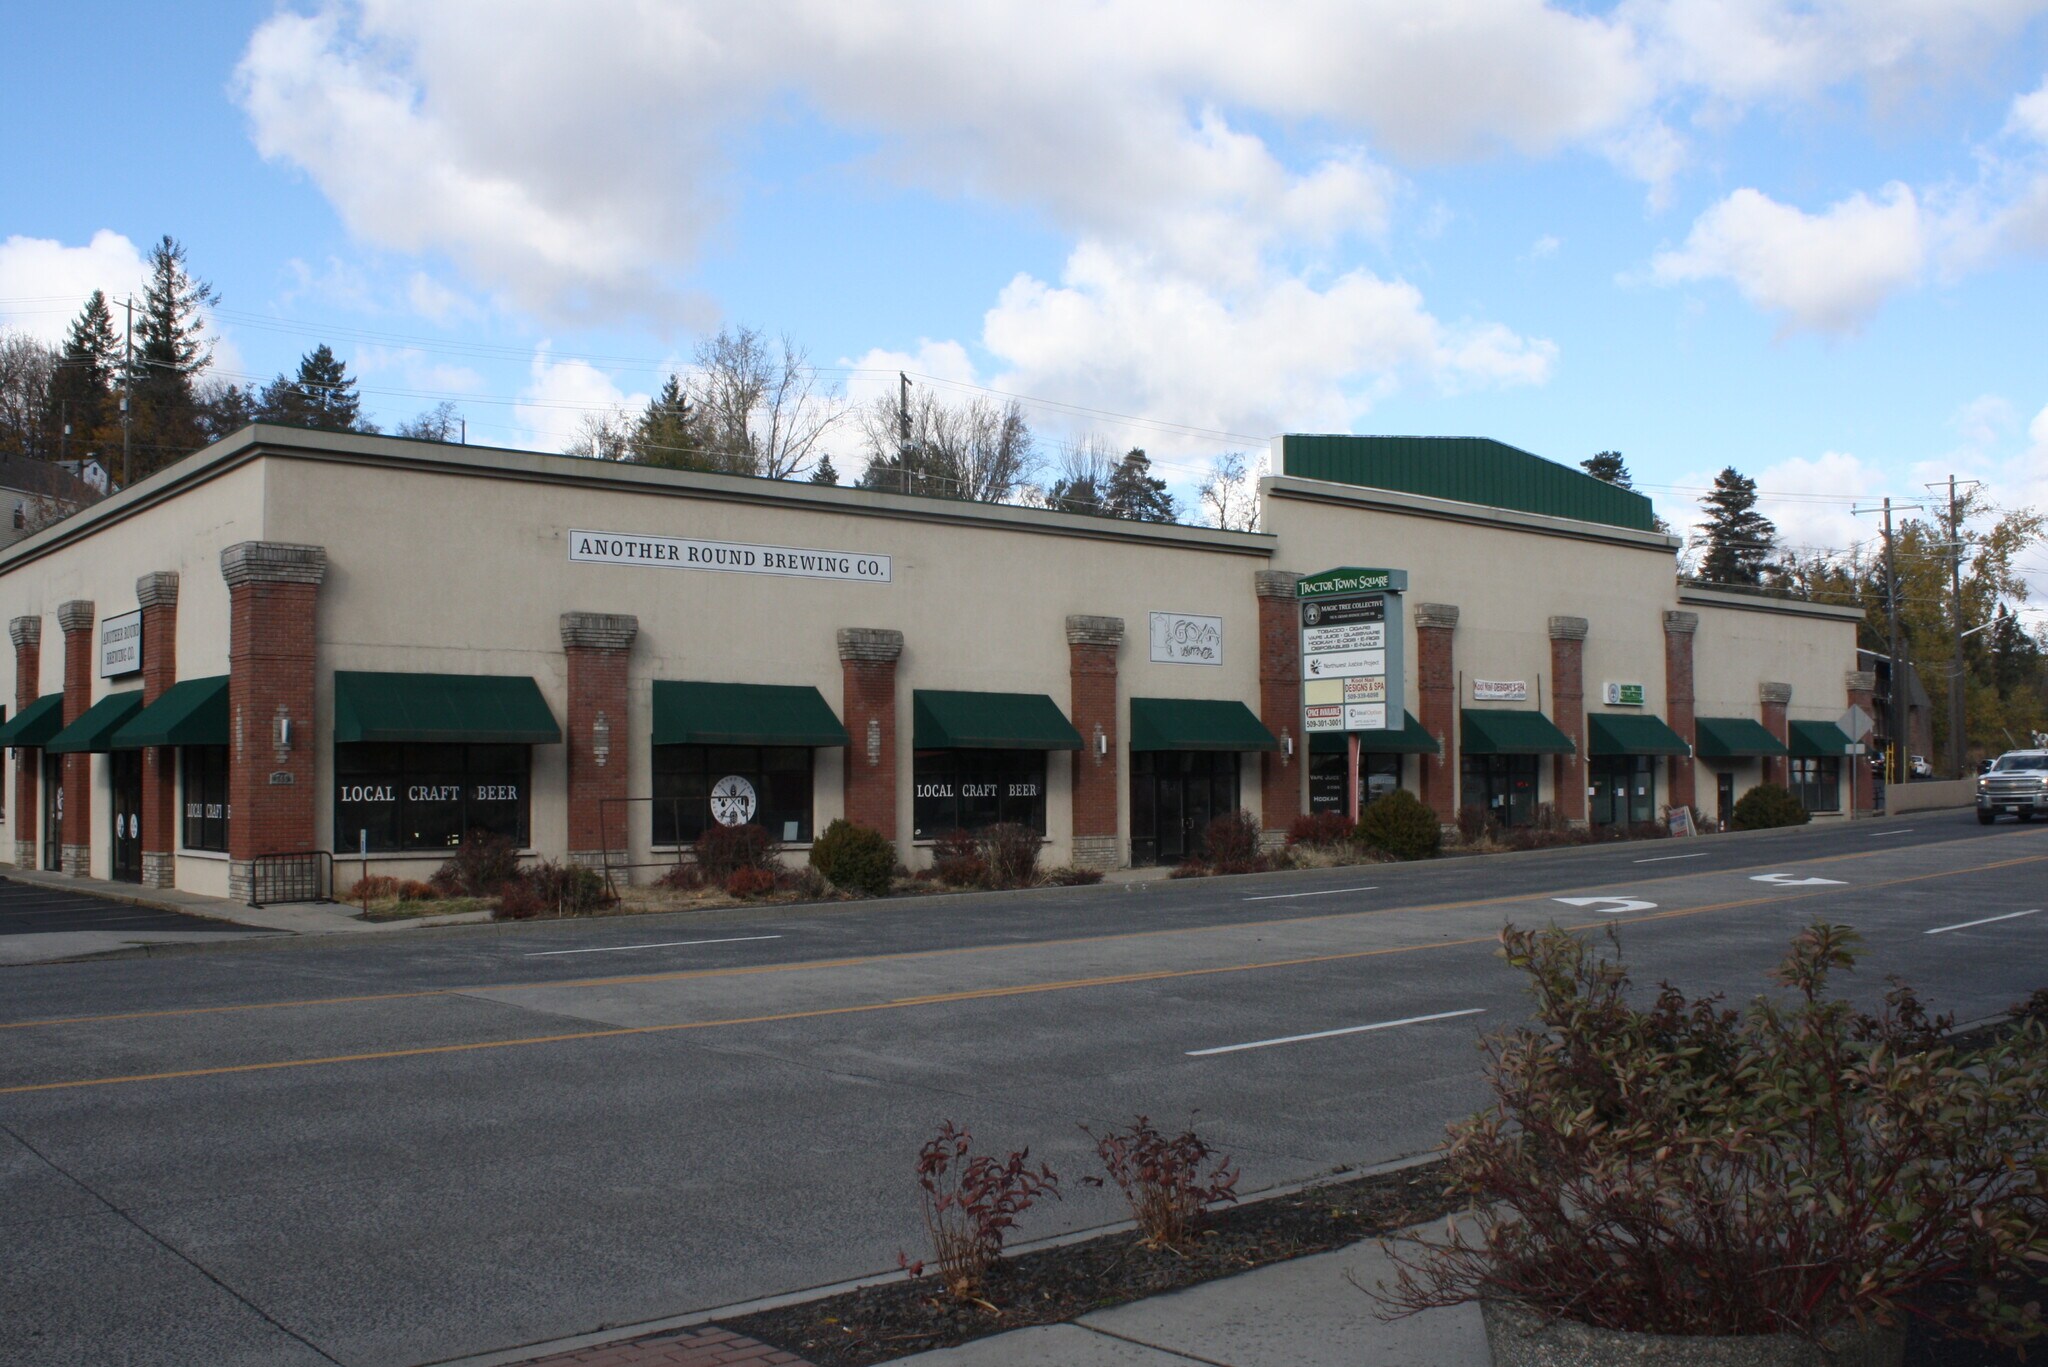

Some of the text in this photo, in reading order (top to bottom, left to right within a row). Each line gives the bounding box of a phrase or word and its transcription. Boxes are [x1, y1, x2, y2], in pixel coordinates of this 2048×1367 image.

[579, 537, 885, 576] ANOTHER ROUND BREWING CO.
[1299, 575, 1388, 595] TRACTOR TOWN SQUARE
[1173, 620, 1220, 646] GOYA
[1345, 682, 1384, 693] DESIGNS & SPA
[1307, 719, 1341, 728] 509-301-3001
[341, 785, 518, 802] LOCAL CRAFT BEER
[917, 784, 1037, 798] LOCAL CRAFT BEER
